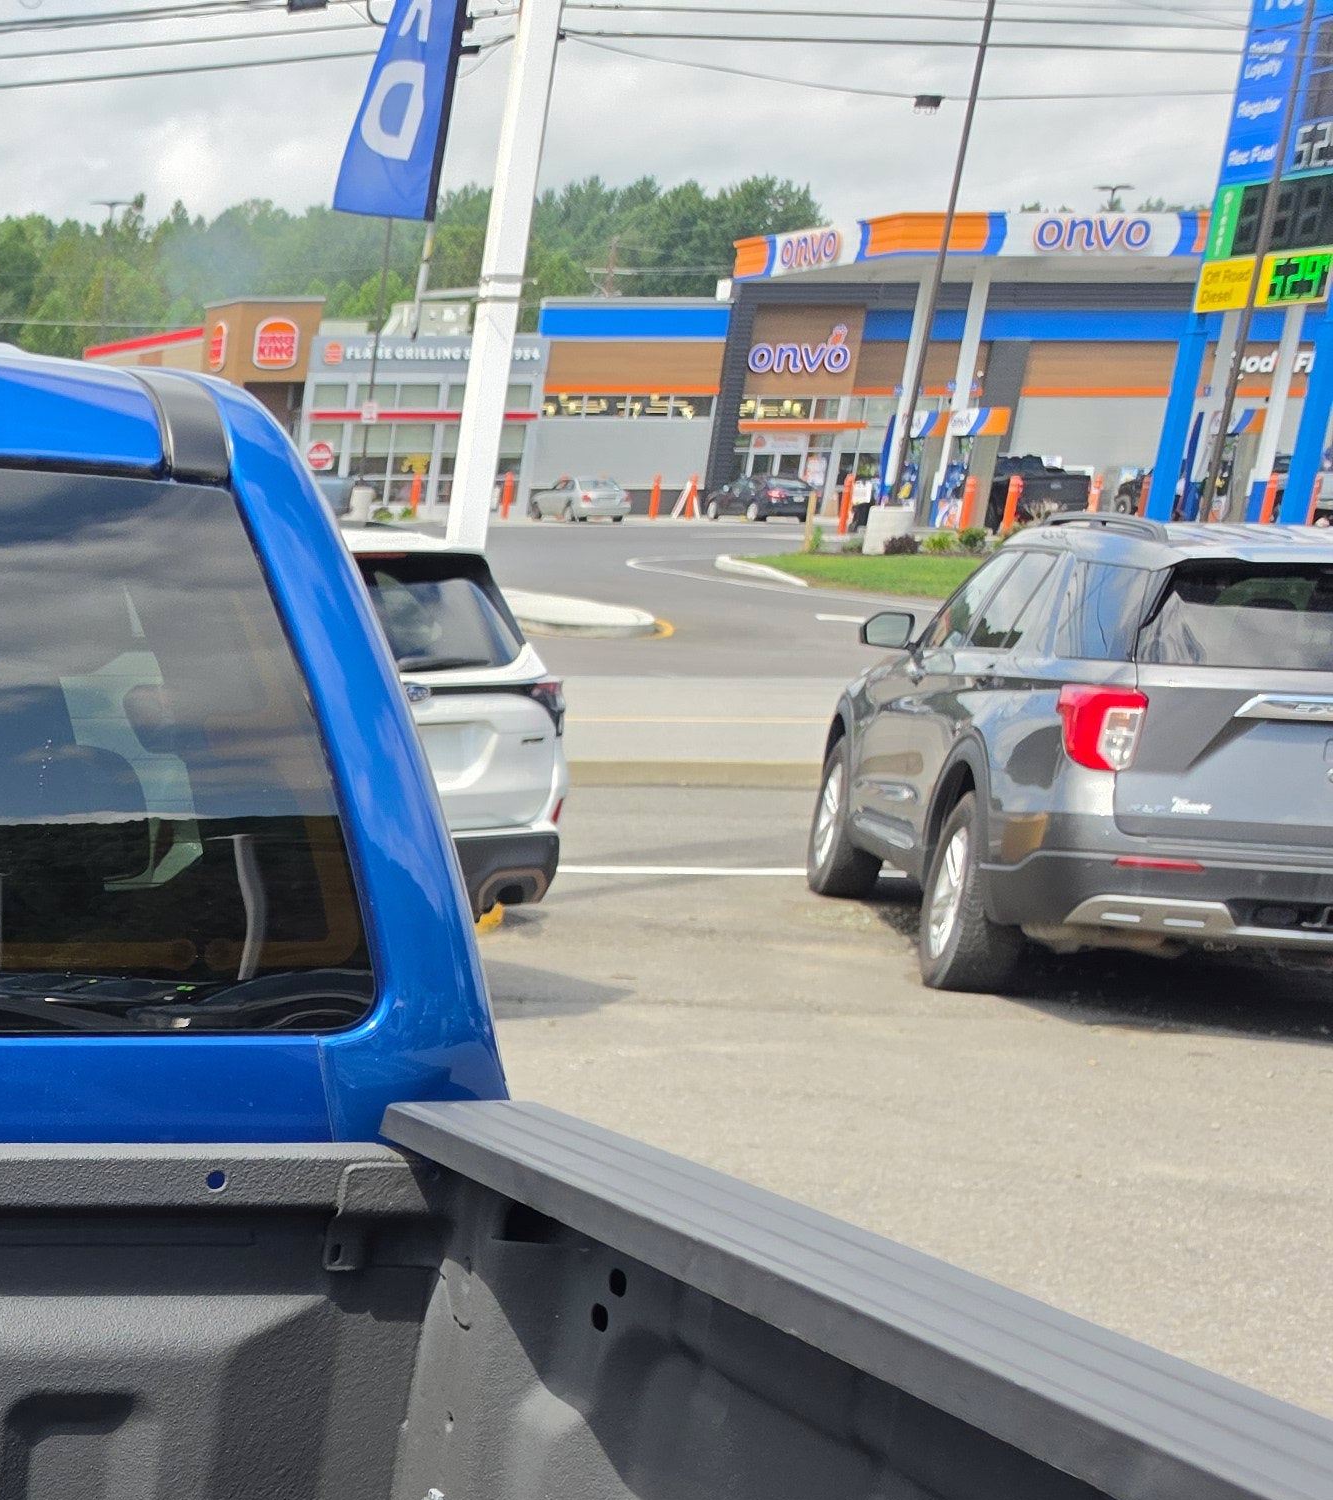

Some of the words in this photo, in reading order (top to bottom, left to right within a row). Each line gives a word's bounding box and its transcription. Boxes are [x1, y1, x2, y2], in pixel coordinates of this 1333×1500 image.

[781, 229, 838, 269] onvo
[1034, 217, 1152, 251] onvo
[258, 345, 294, 358] KING
[514, 347, 540, 360] 954
[748, 343, 851, 373] onvo
